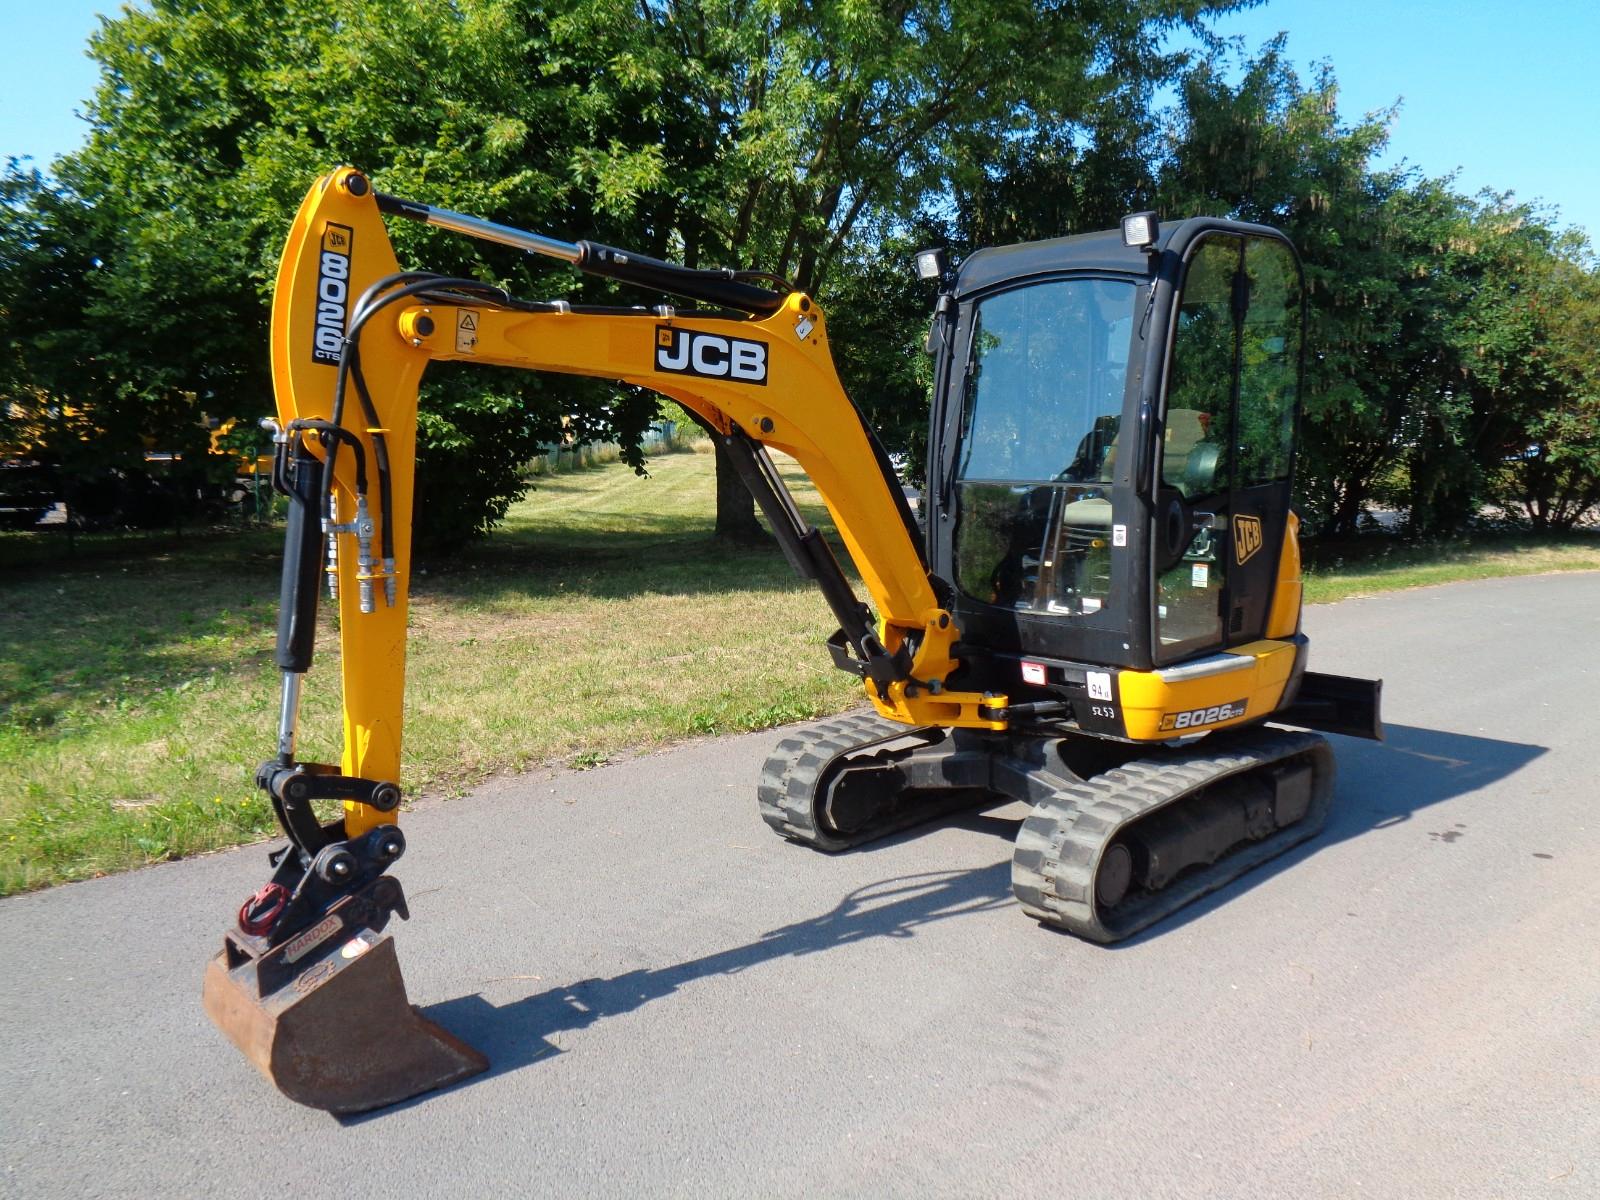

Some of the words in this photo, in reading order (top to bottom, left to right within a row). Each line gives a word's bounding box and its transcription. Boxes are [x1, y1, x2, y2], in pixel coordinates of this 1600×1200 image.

[315, 252, 348, 352] 8026
[315, 351, 341, 361] CTS
[658, 332, 766, 381] JCB
[1237, 519, 1260, 558] JCB
[1175, 704, 1232, 729] 8026
[287, 918, 337, 957] HARDOX
